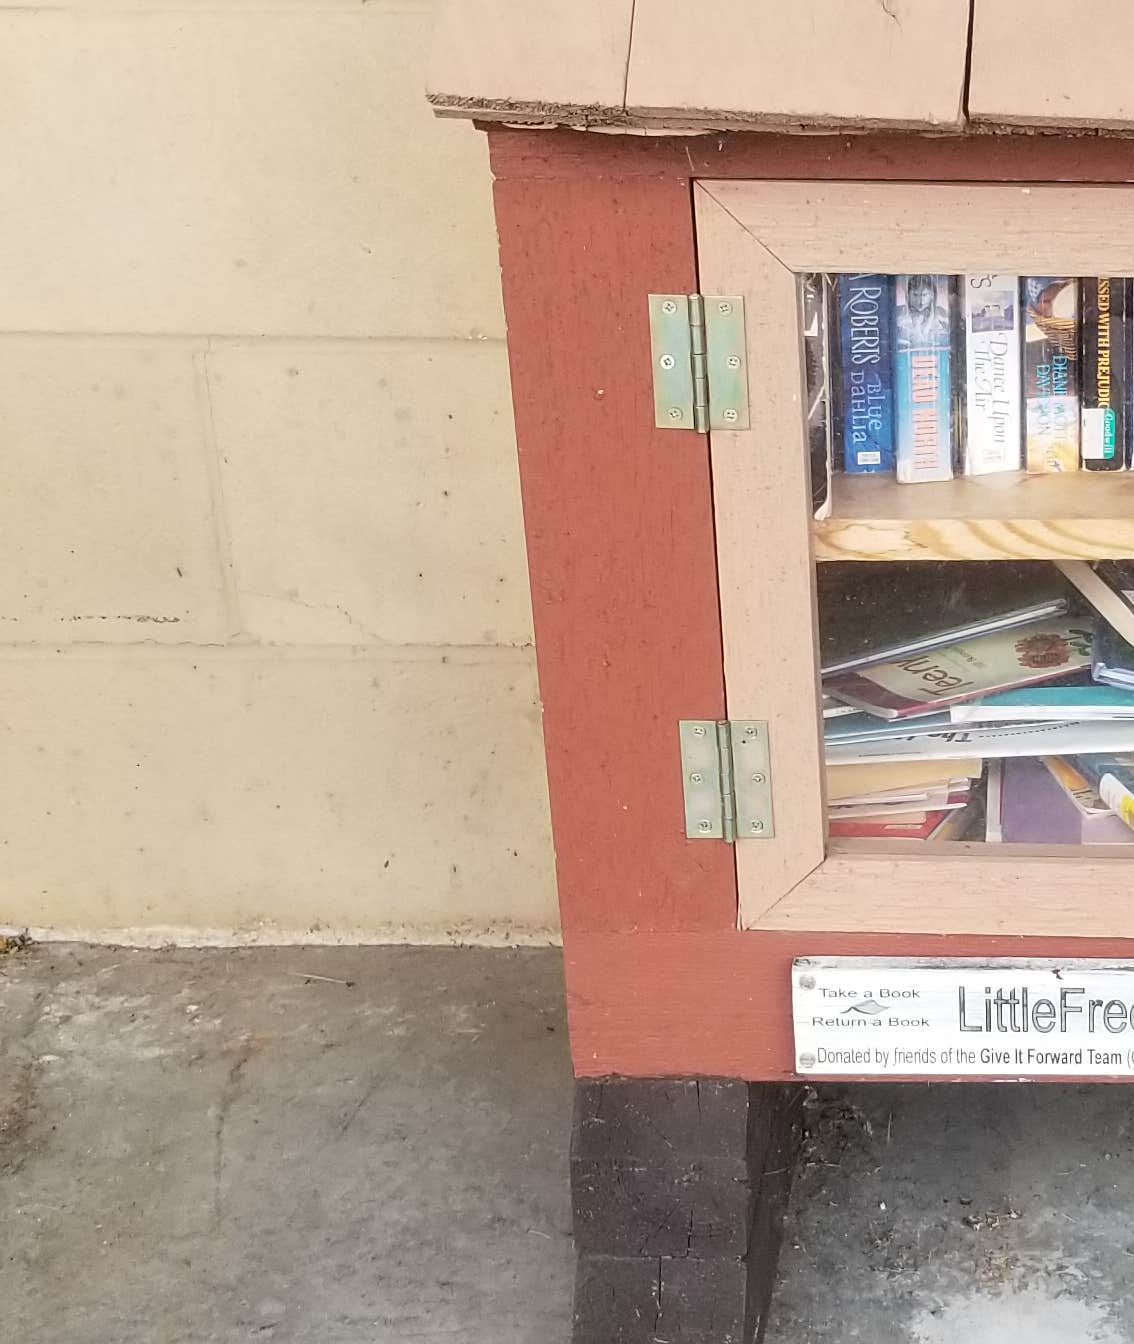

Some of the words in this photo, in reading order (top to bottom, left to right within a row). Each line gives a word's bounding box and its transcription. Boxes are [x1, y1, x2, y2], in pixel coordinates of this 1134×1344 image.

[844, 287, 882, 365] ROBERTS
[1097, 313, 1110, 347] WITH
[1103, 413, 1114, 454] Goodwill
[820, 988, 857, 999] Take
[864, 991, 873, 999] a
[880, 988, 920, 999] Book
[812, 1016, 868, 1027] Return
[872, 1019, 882, 1027] a
[888, 1016, 930, 1027] Book
[817, 1047, 870, 1064] Donated
[875, 1048, 889, 1069] by
[892, 1047, 936, 1066] friends
[941, 1047, 953, 1065] of
[957, 1048, 976, 1065] the
[980, 1048, 1010, 1065] Give
[1014, 1049, 1023, 1065] It
[1027, 1048, 1082, 1065] Forward
[1087, 1048, 1122, 1065] Team
